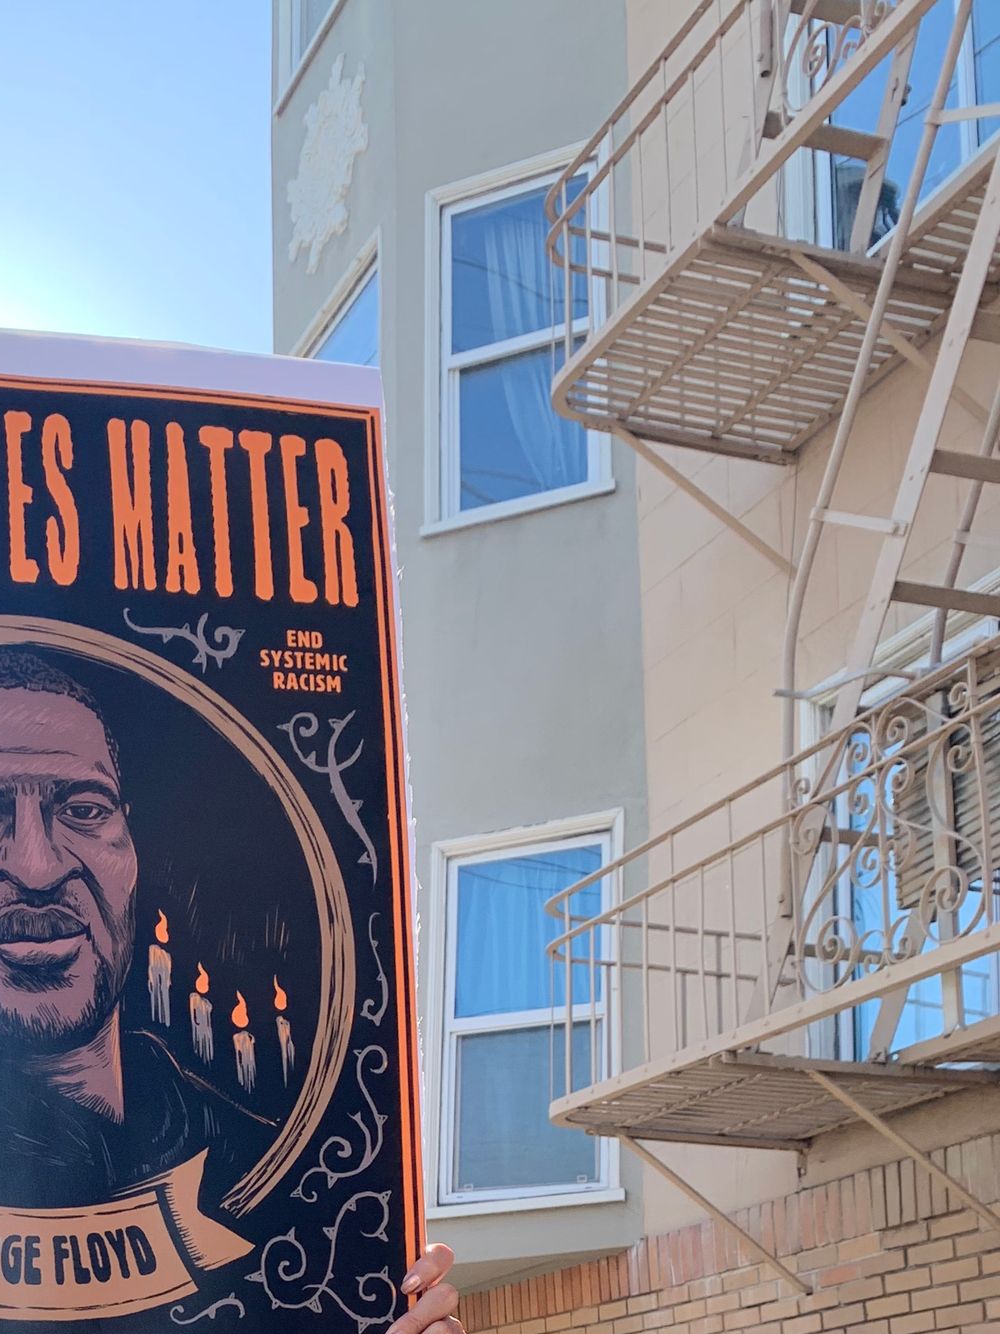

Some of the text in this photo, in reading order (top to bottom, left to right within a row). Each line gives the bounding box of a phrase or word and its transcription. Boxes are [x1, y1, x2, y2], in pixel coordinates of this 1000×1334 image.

[106, 418, 359, 607] MATTER
[286, 630, 323, 649] END
[260, 650, 348, 673] SYSTEMIC
[272, 671, 342, 693] RACISM
[52, 1225, 157, 1285] FLOYD
